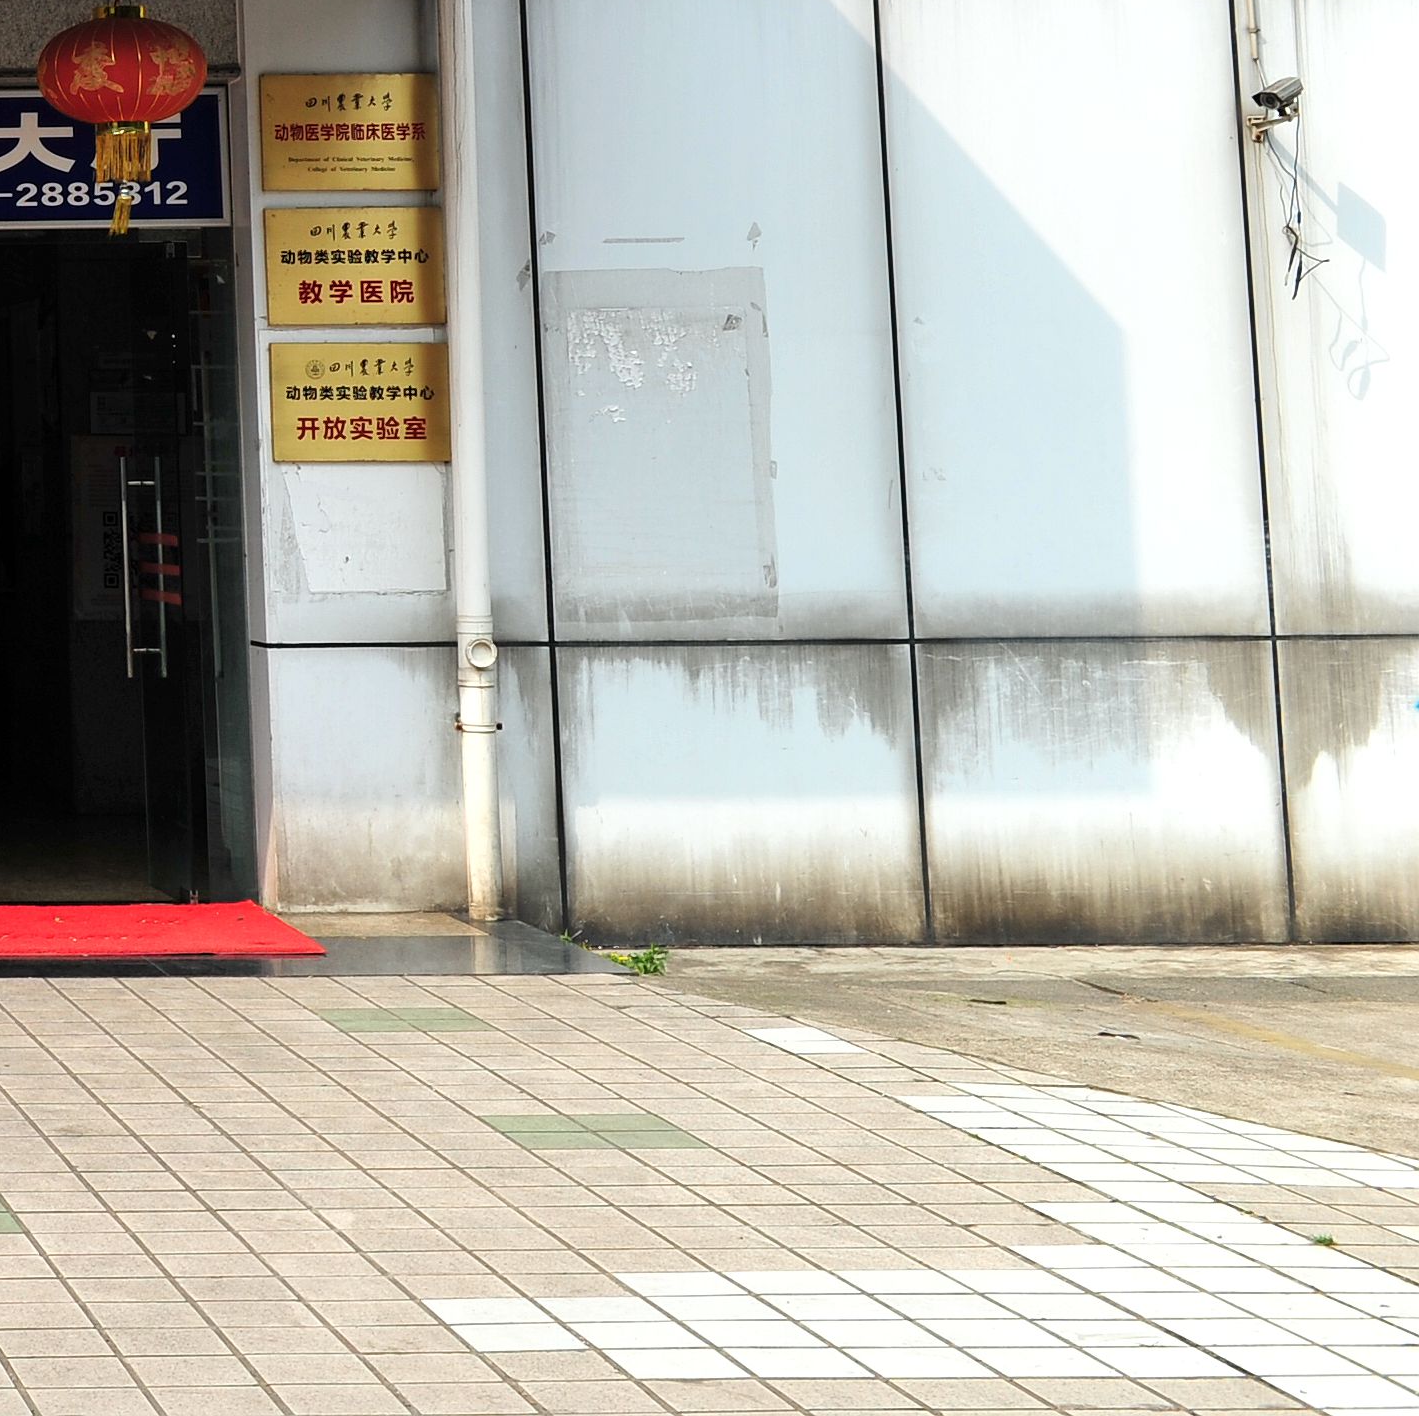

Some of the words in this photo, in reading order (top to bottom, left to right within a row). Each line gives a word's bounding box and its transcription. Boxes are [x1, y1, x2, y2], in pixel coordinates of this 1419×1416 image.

[274, 122, 427, 142] 动物医学院临床医学系
[280, 248, 430, 265] 动物类实验教学中心
[298, 280, 416, 305] 教学医院
[285, 385, 435, 402] 动物类实验教学中心
[296, 416, 428, 441] 开放实验室
